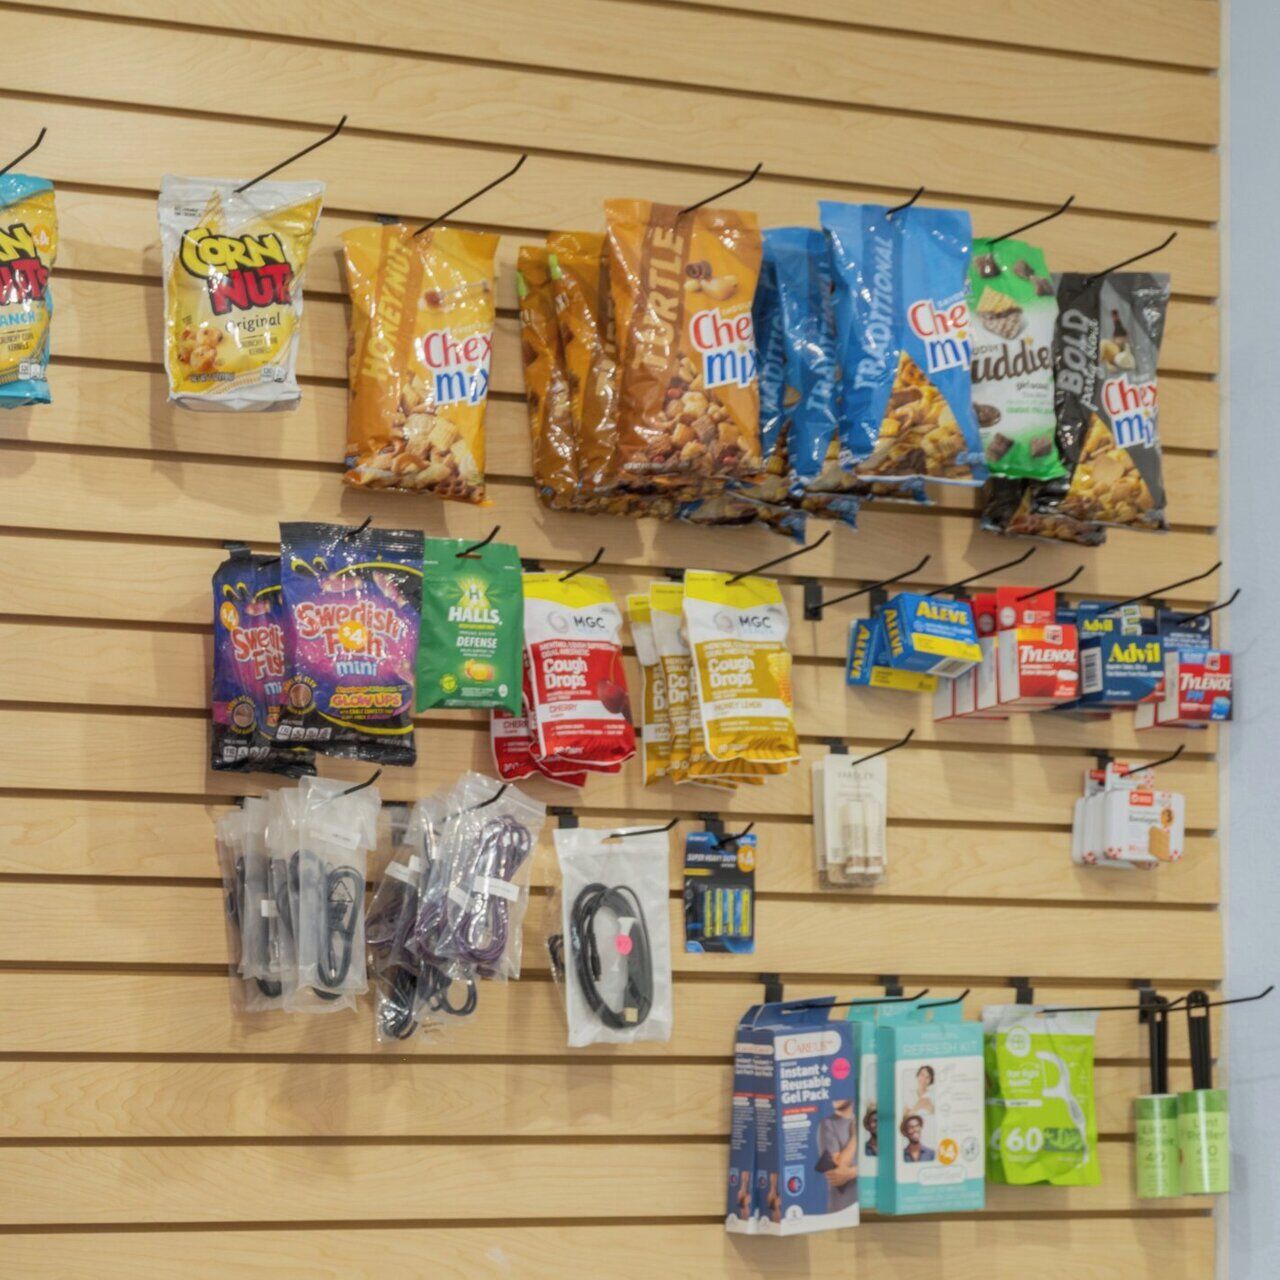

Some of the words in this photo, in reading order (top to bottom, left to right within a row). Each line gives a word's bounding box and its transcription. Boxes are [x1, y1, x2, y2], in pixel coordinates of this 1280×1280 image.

[179, 227, 287, 279] CORN
[361, 290, 403, 381] HONEY
[384, 236, 413, 294] NUT
[631, 226, 685, 372] TURTLE
[855, 236, 895, 390] TRADITIONAL
[423, 330, 493, 369] Chex
[1056, 309, 1091, 396] BOLD
[435, 366, 490, 404] mix
[1103, 375, 1159, 416] Chex
[296, 602, 405, 640] Swedish
[448, 607, 499, 624] HALLS
[574, 616, 605, 629] MGC
[740, 616, 772, 628] MGC
[915, 601, 969, 626] ALEVE
[343, 625, 363, 645] $4
[456, 637, 497, 649] DEFENSE
[883, 609, 903, 657] ALEVE
[850, 624, 870, 679] ALEVE
[1019, 645, 1077, 664] TYLENOL
[1108, 642, 1161, 664] Advil
[336, 660, 377, 676] mini
[543, 657, 588, 675] Cough
[707, 656, 755, 674] Cough
[545, 674, 587, 690] Drops
[710, 671, 753, 688] Drops
[1181, 673, 1232, 692] TYLENOL
[780, 1065, 820, 1079] Instant
[780, 1076, 832, 1092] Reusable
[781, 1091, 801, 1104] Gel
[803, 1088, 829, 1101] Pack
[1006, 1126, 1042, 1153] 60
